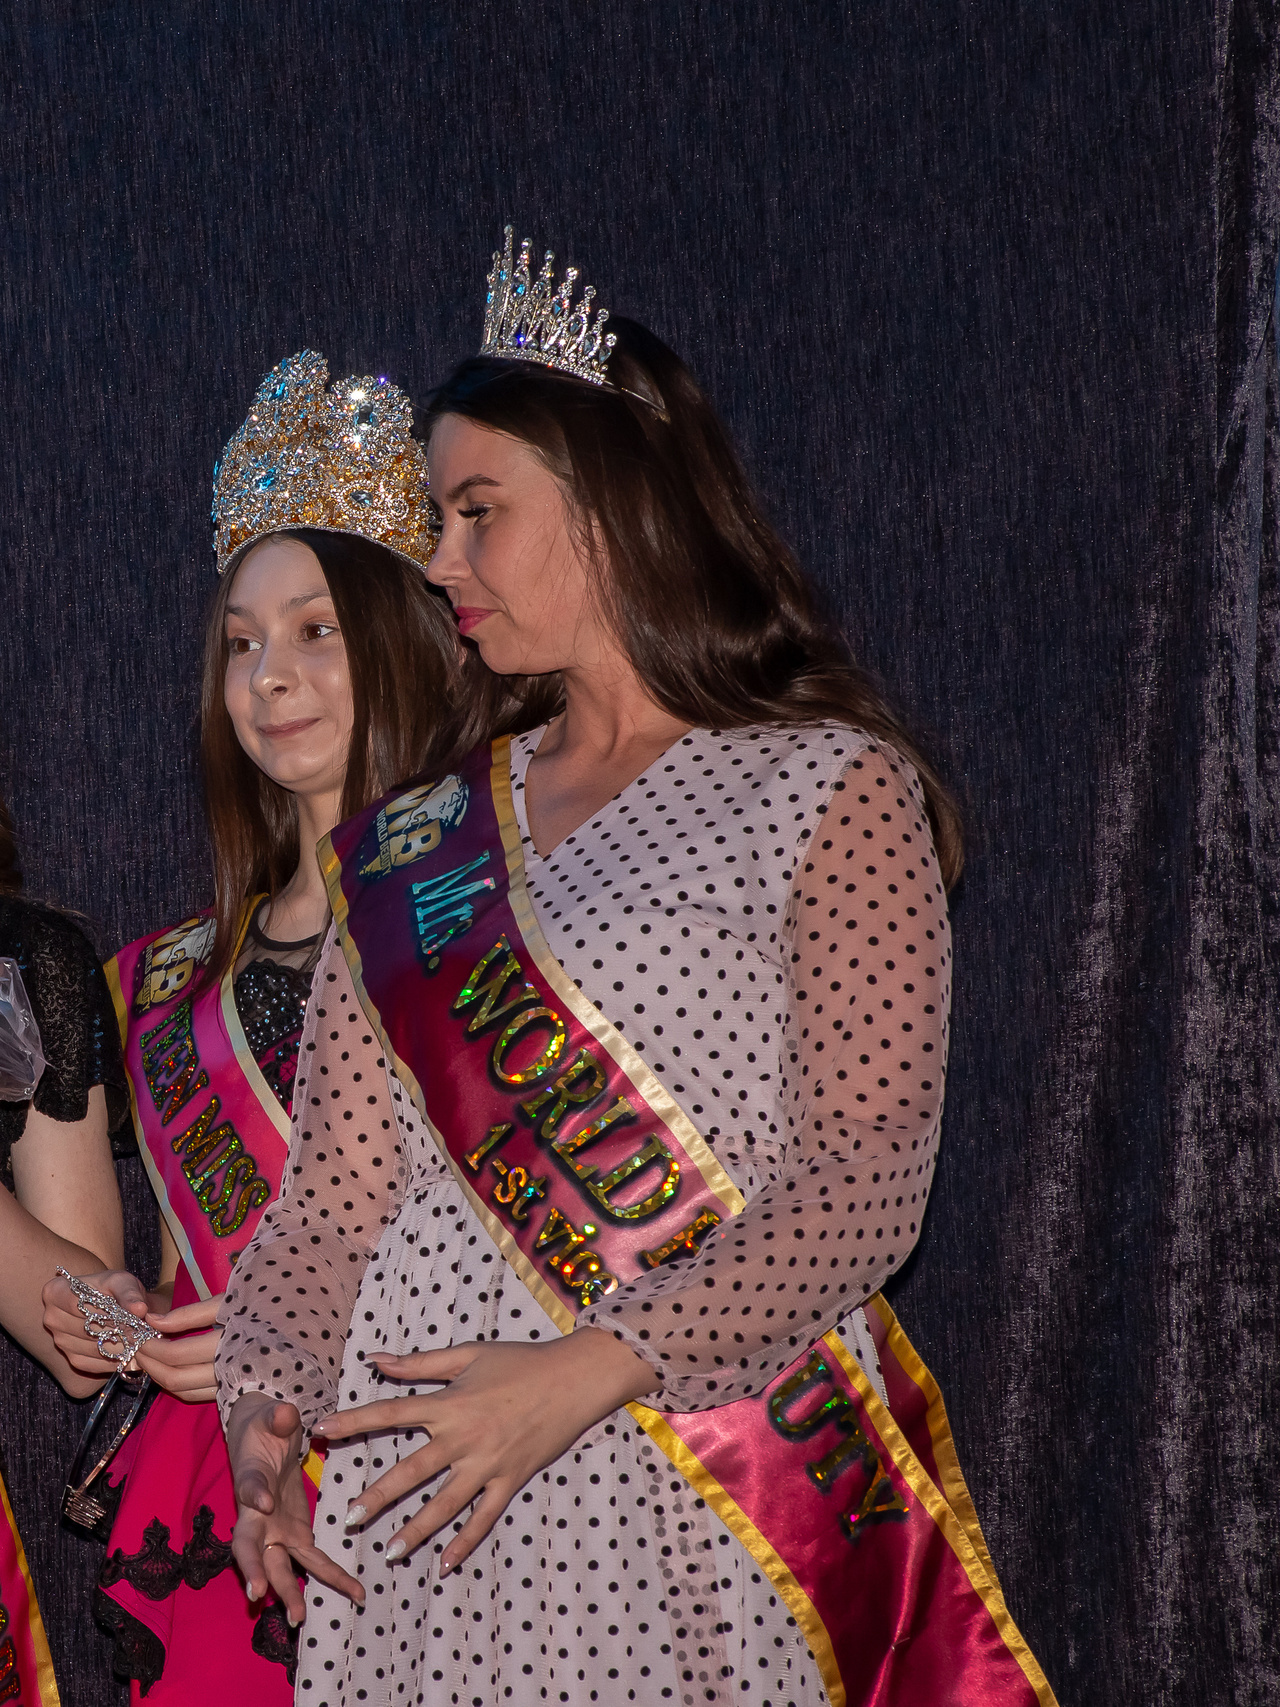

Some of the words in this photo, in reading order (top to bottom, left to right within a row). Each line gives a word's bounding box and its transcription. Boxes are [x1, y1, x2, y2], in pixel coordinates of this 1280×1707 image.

[376, 807, 388, 842] WORLD
[379, 840, 392, 876] BEAUTY
[412, 849, 496, 970] Mrs.
[453, 933, 681, 1220] WORLD
[172, 1097, 269, 1235] MISS
[464, 1122, 546, 1221] 1-st
